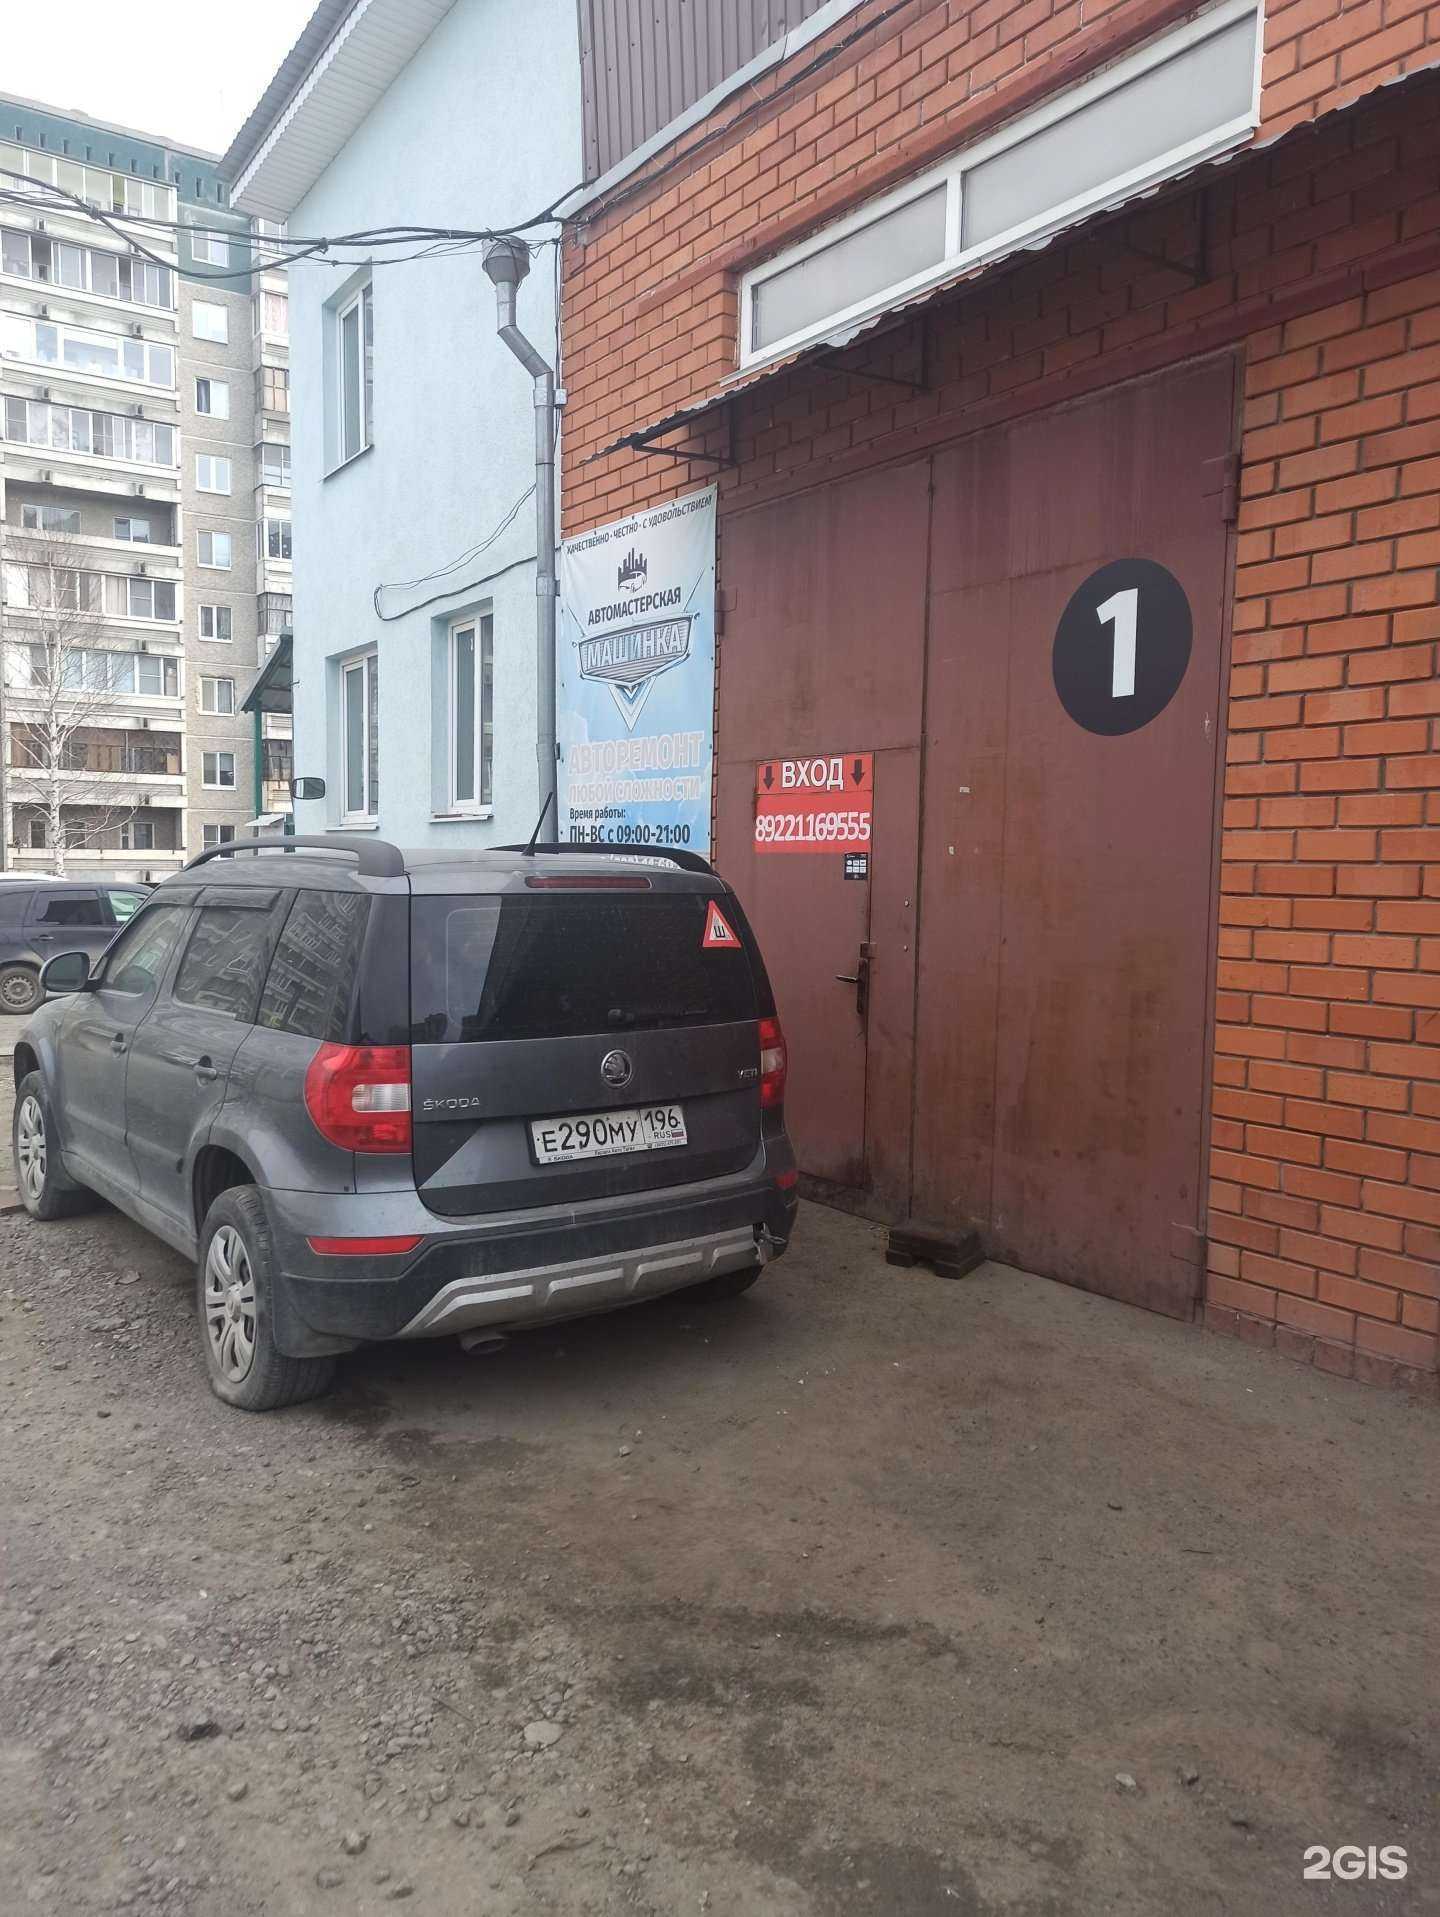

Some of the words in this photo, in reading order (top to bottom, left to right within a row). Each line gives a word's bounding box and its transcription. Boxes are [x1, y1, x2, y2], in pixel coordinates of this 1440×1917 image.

[567, 532, 609, 555] КАЧЕСТВЕННО
[614, 523, 639, 540] ЧЕСТНО
[642, 520, 648, 529] С
[648, 494, 713, 528] УДОВОЛЬСТВИЕМ
[588, 586, 682, 626] АВТОМАСТЕРСКАЯ
[587, 624, 682, 669] МАШИНКА
[1096, 588, 1139, 698] 1
[568, 731, 705, 776] АВТОРЕМОНТ
[568, 777, 614, 805] ЛЮБОЙ
[615, 775, 701, 802] СЛОЖНОСТИ
[782, 758, 844, 791] ВХОД
[569, 807, 594, 822] Время
[594, 806, 626, 821] работы:
[755, 811, 871, 842] 89221169555
[569, 825, 605, 843] ПН-ВС
[616, 824, 691, 844] 09:00-21:00
[644, 1108, 680, 1131] 196
[653, 1130, 672, 1139] RUS
